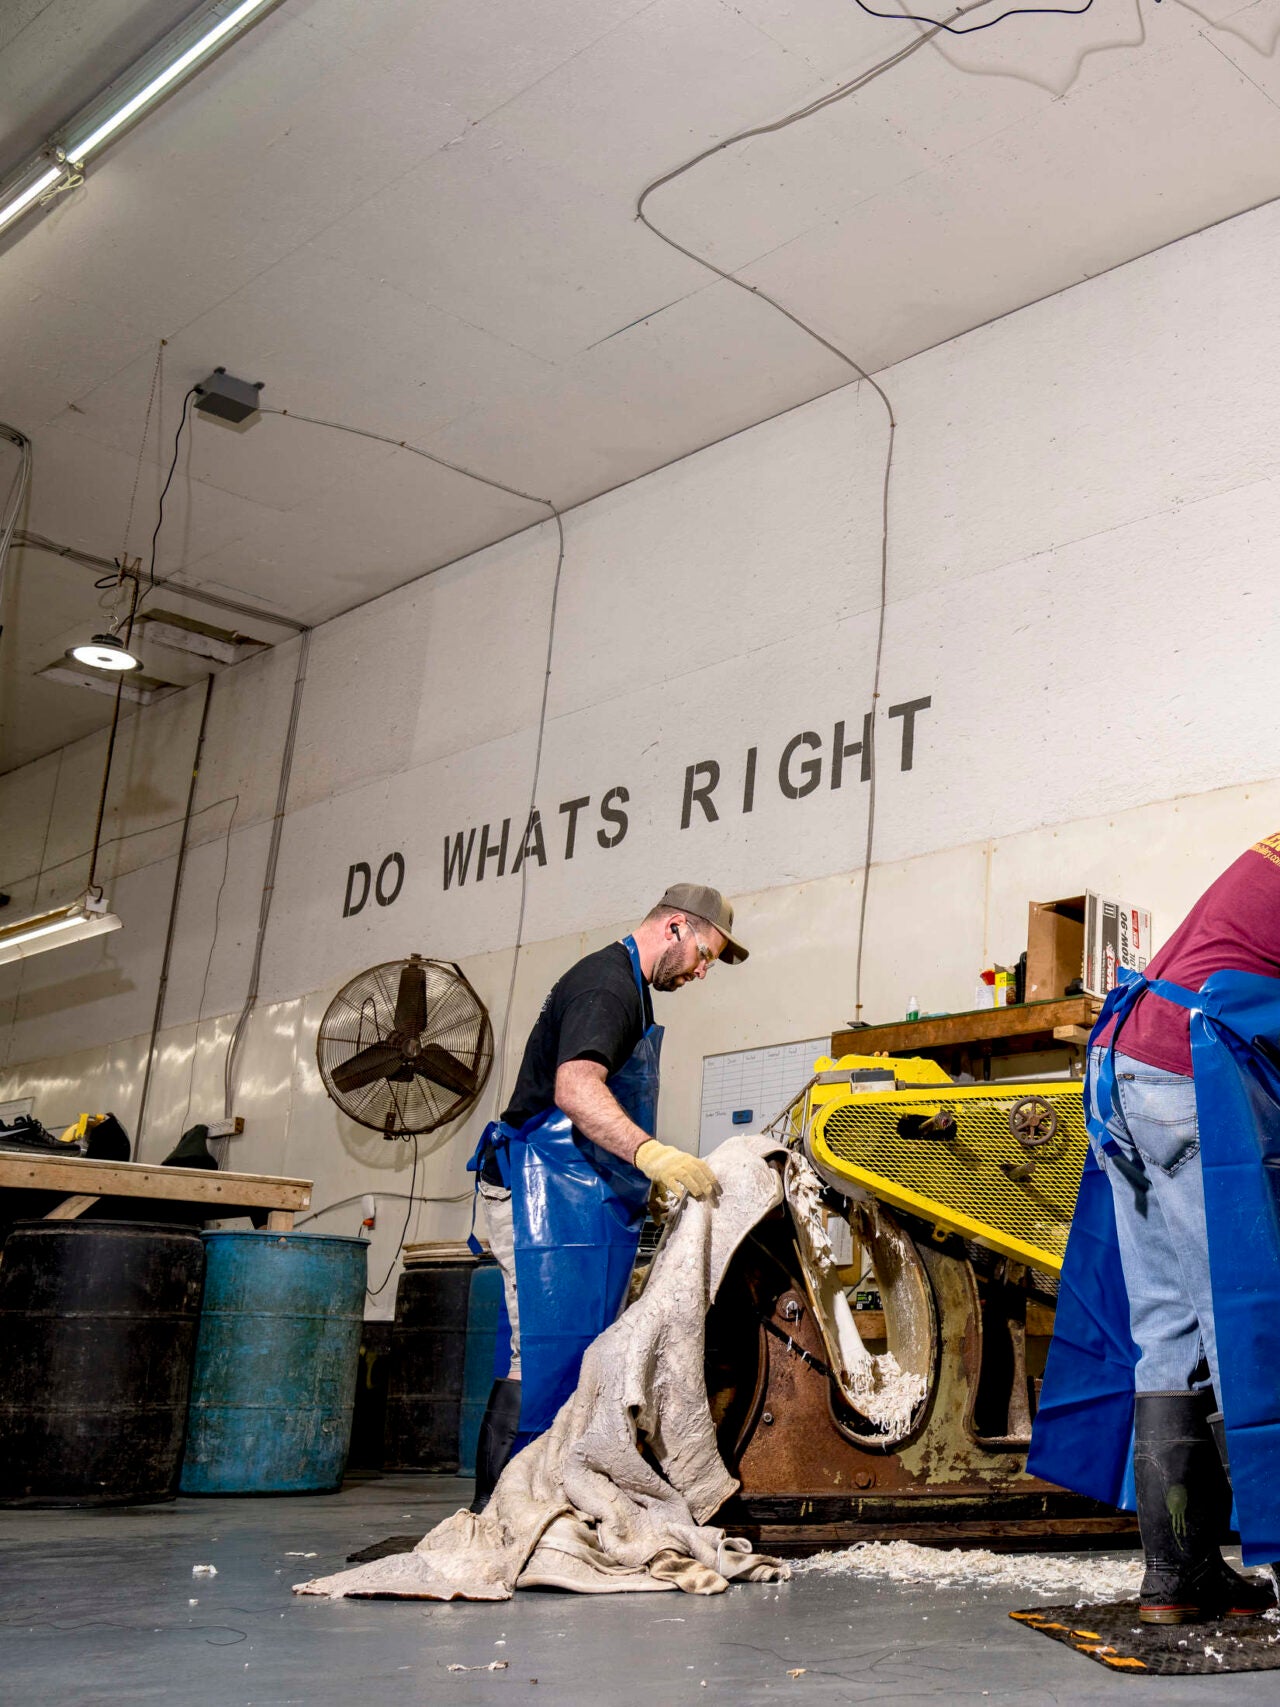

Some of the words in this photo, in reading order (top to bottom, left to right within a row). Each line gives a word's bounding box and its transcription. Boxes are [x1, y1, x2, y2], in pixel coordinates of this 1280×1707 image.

[342, 851, 405, 918] DO
[443, 786, 630, 890] WHATS
[680, 696, 932, 830] RIGHT
[1120, 911, 1130, 965] 80W-90
